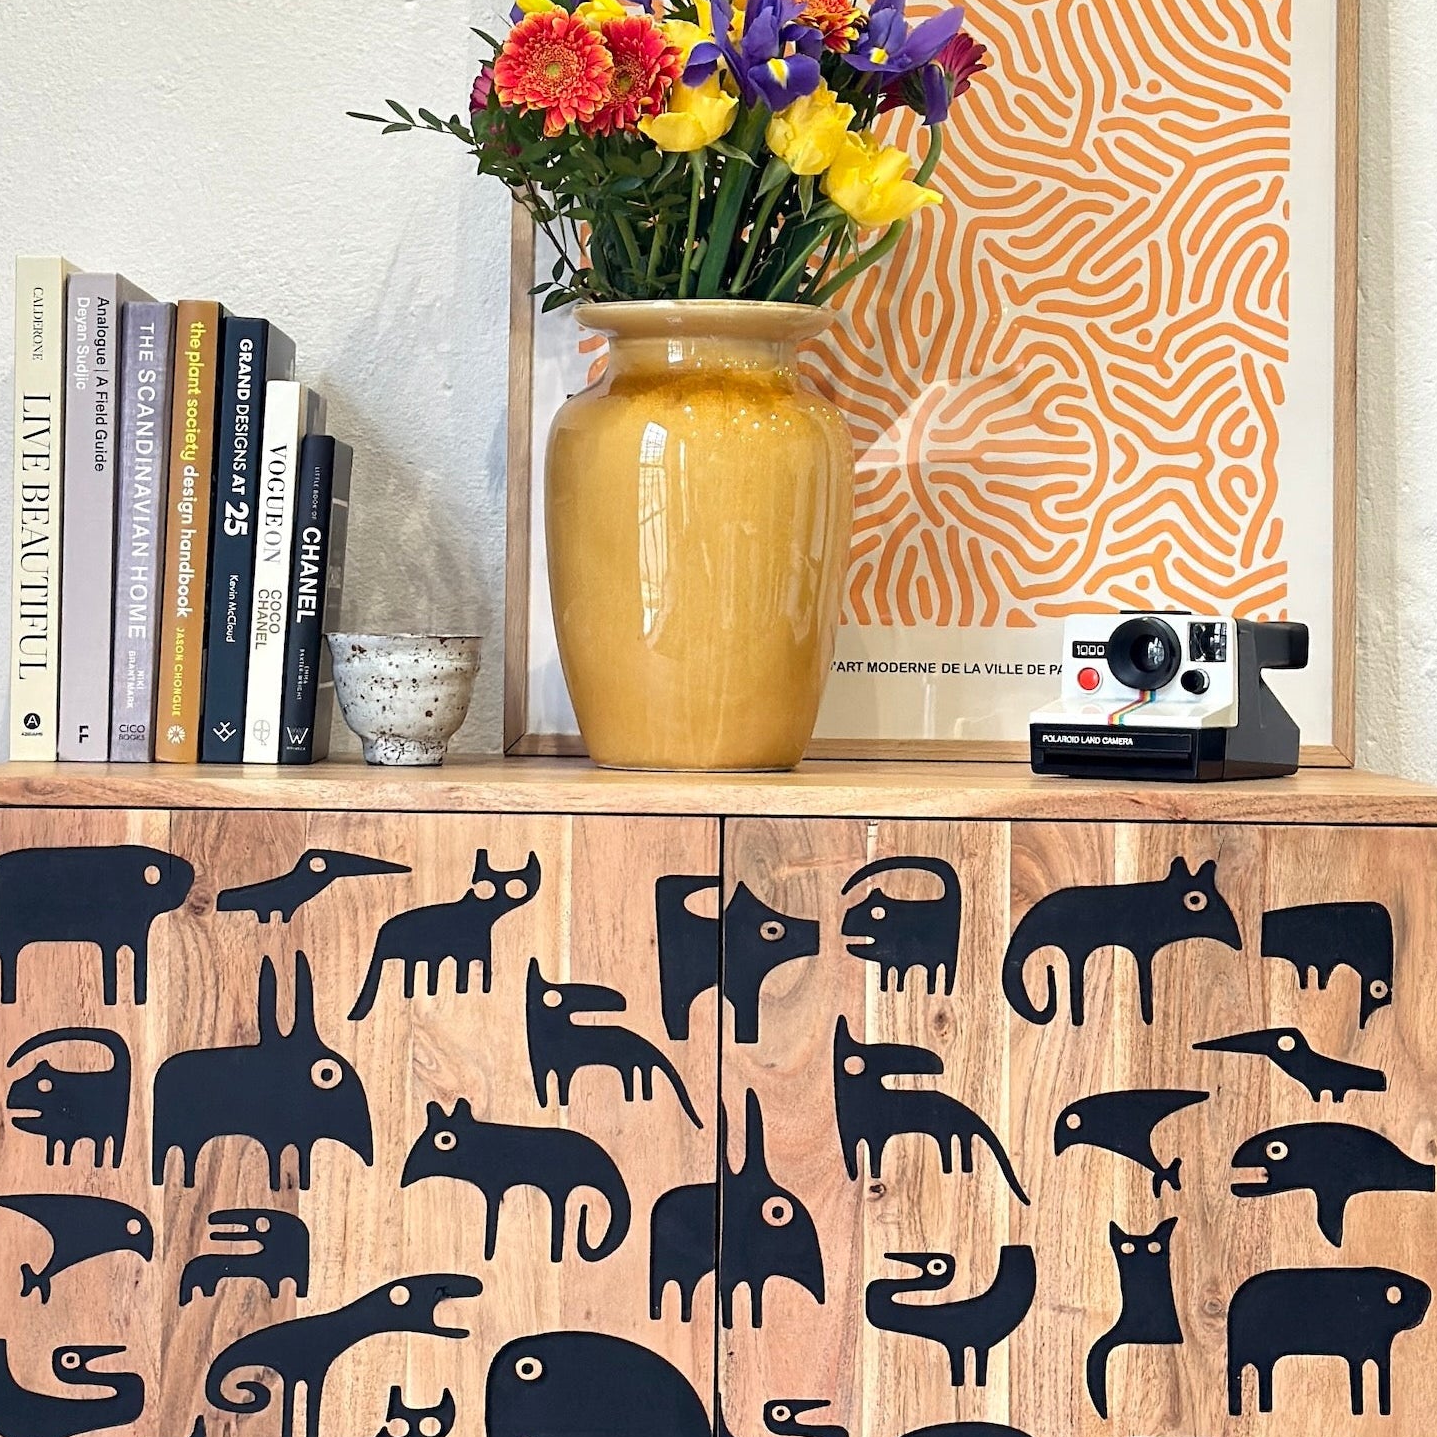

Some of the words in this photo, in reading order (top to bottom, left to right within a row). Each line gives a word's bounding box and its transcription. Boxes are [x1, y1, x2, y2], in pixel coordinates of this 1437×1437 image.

[32, 287, 45, 361] CALDERONE
[73, 297, 90, 342] Deyan
[94, 296, 110, 365] Analogue
[138, 322, 155, 361] THE
[189, 321, 206, 349] the
[72, 345, 90, 391] Sudjic
[95, 376, 108, 388] A
[184, 351, 204, 395] plant
[236, 338, 253, 401] GRAND
[95, 391, 108, 426] Field
[180, 398, 201, 462] society
[21, 393, 51, 471] LIVE
[94, 429, 108, 472] Guide
[232, 404, 250, 471] DESIGNS
[131, 369, 157, 556] SCANDINAVIAN
[231, 474, 246, 495] AT
[265, 444, 288, 526] VOGUE
[177, 465, 198, 524] design
[223, 501, 249, 537] 25
[263, 530, 282, 563] ON
[18, 481, 51, 679] BEAUTIFUL
[176, 528, 196, 618] handbook
[228, 574, 238, 600] Kevin
[297, 526, 321, 623] CHANEL
[128, 566, 149, 639] HOME
[225, 601, 237, 643] McCloud
[255, 589, 269, 650] CHANEL
[269, 589, 282, 634] COCO
[174, 626, 184, 661] JASON
[1076, 645, 1105, 656] 1000
[171, 664, 183, 717] CHONGUE
[867, 662, 937, 674] MODERNE
[941, 663, 960, 674] DE
[963, 663, 981, 674] LA
[984, 664, 1023, 675] VILLE
[1027, 664, 1045, 675] DE
[119, 724, 145, 733] CICO
[1042, 735, 1080, 744] POLAROID
[1081, 736, 1101, 745] LAND
[1102, 737, 1134, 746] CAMERA
